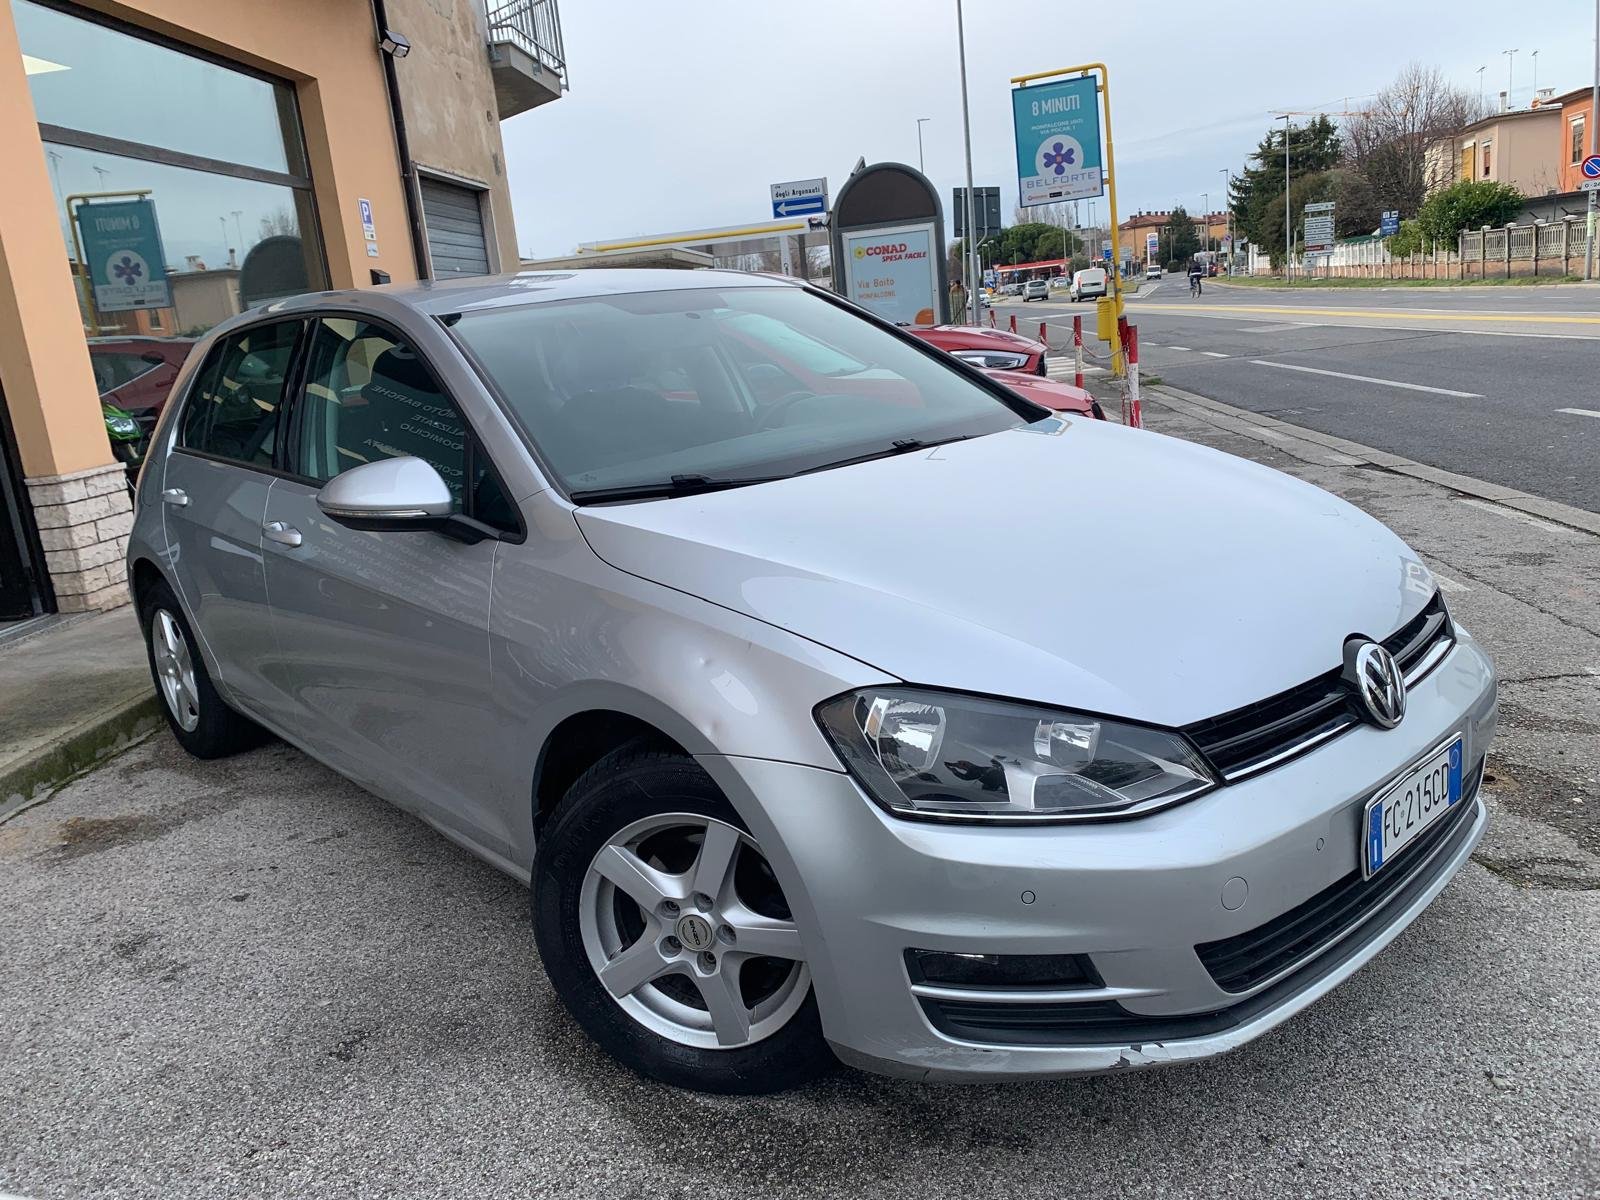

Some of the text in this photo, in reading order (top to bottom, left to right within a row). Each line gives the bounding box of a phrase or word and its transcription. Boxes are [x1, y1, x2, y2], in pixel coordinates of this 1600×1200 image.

[1032, 94, 1080, 116] 8 MINUTI
[1026, 172, 1096, 189] BELFORTE
[775, 186, 820, 198] degli Argonauti
[362, 203, 369, 222] P
[866, 243, 908, 257] CONAD
[882, 251, 927, 263] SPESA FACILE
[857, 277, 895, 289] Via Boito
[858, 290, 896, 300] MONFALCONE
